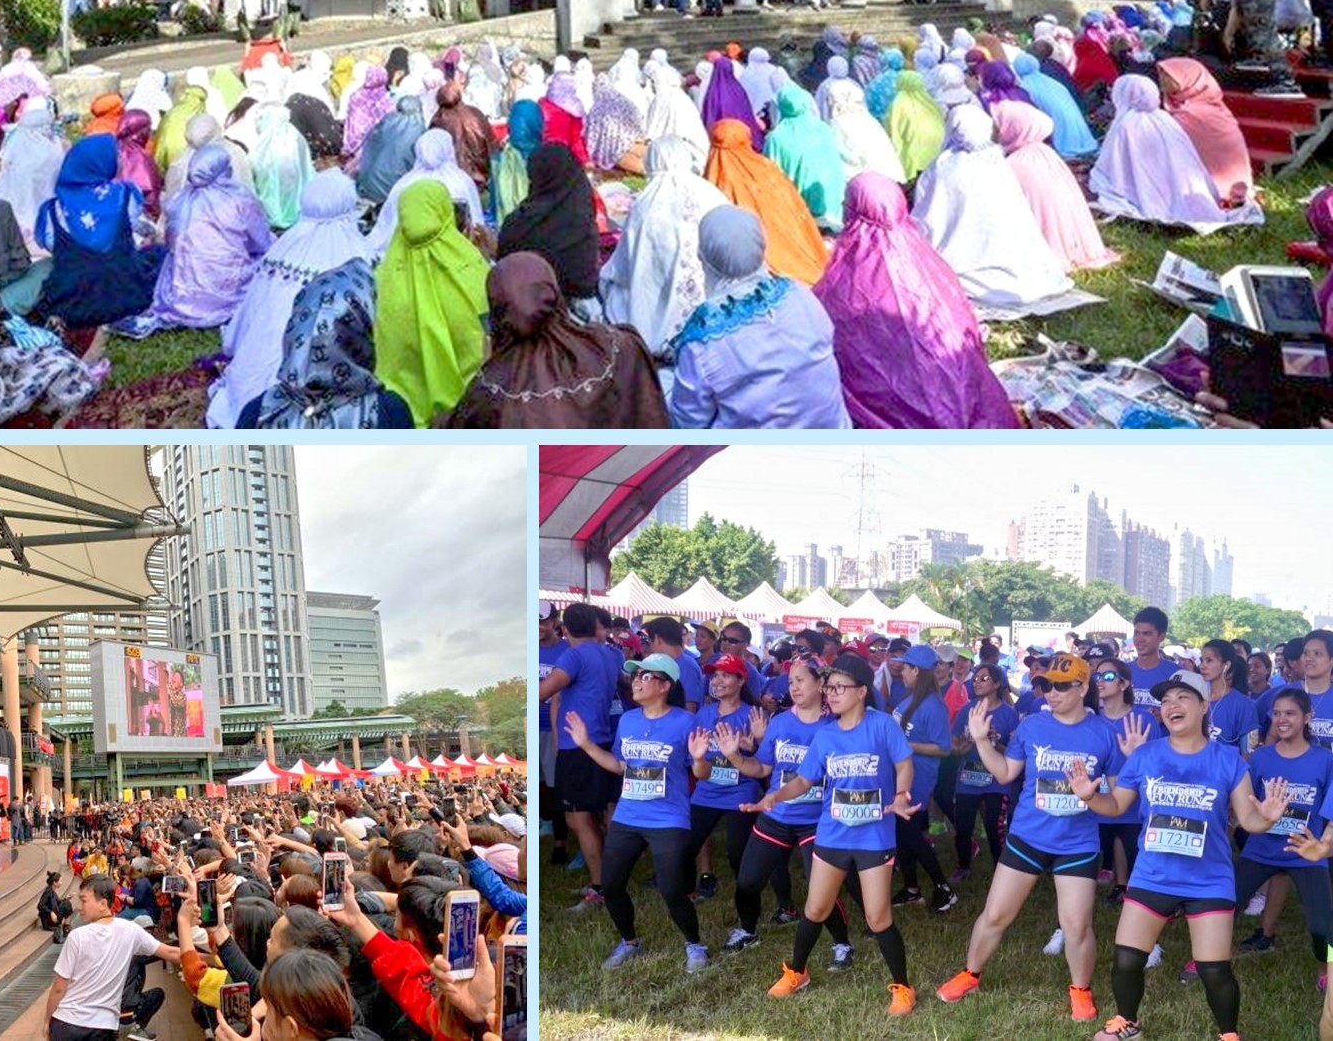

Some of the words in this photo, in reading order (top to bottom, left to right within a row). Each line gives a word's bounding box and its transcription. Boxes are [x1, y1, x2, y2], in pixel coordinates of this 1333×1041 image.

[712, 767, 730, 779] 974
[631, 781, 655, 794] 1749
[1047, 797, 1076, 809] 1720
[1201, 788, 1218, 808] 2
[841, 806, 870, 819] 0900
[1276, 820, 1296, 830] 965
[1158, 831, 1191, 847] 1721
